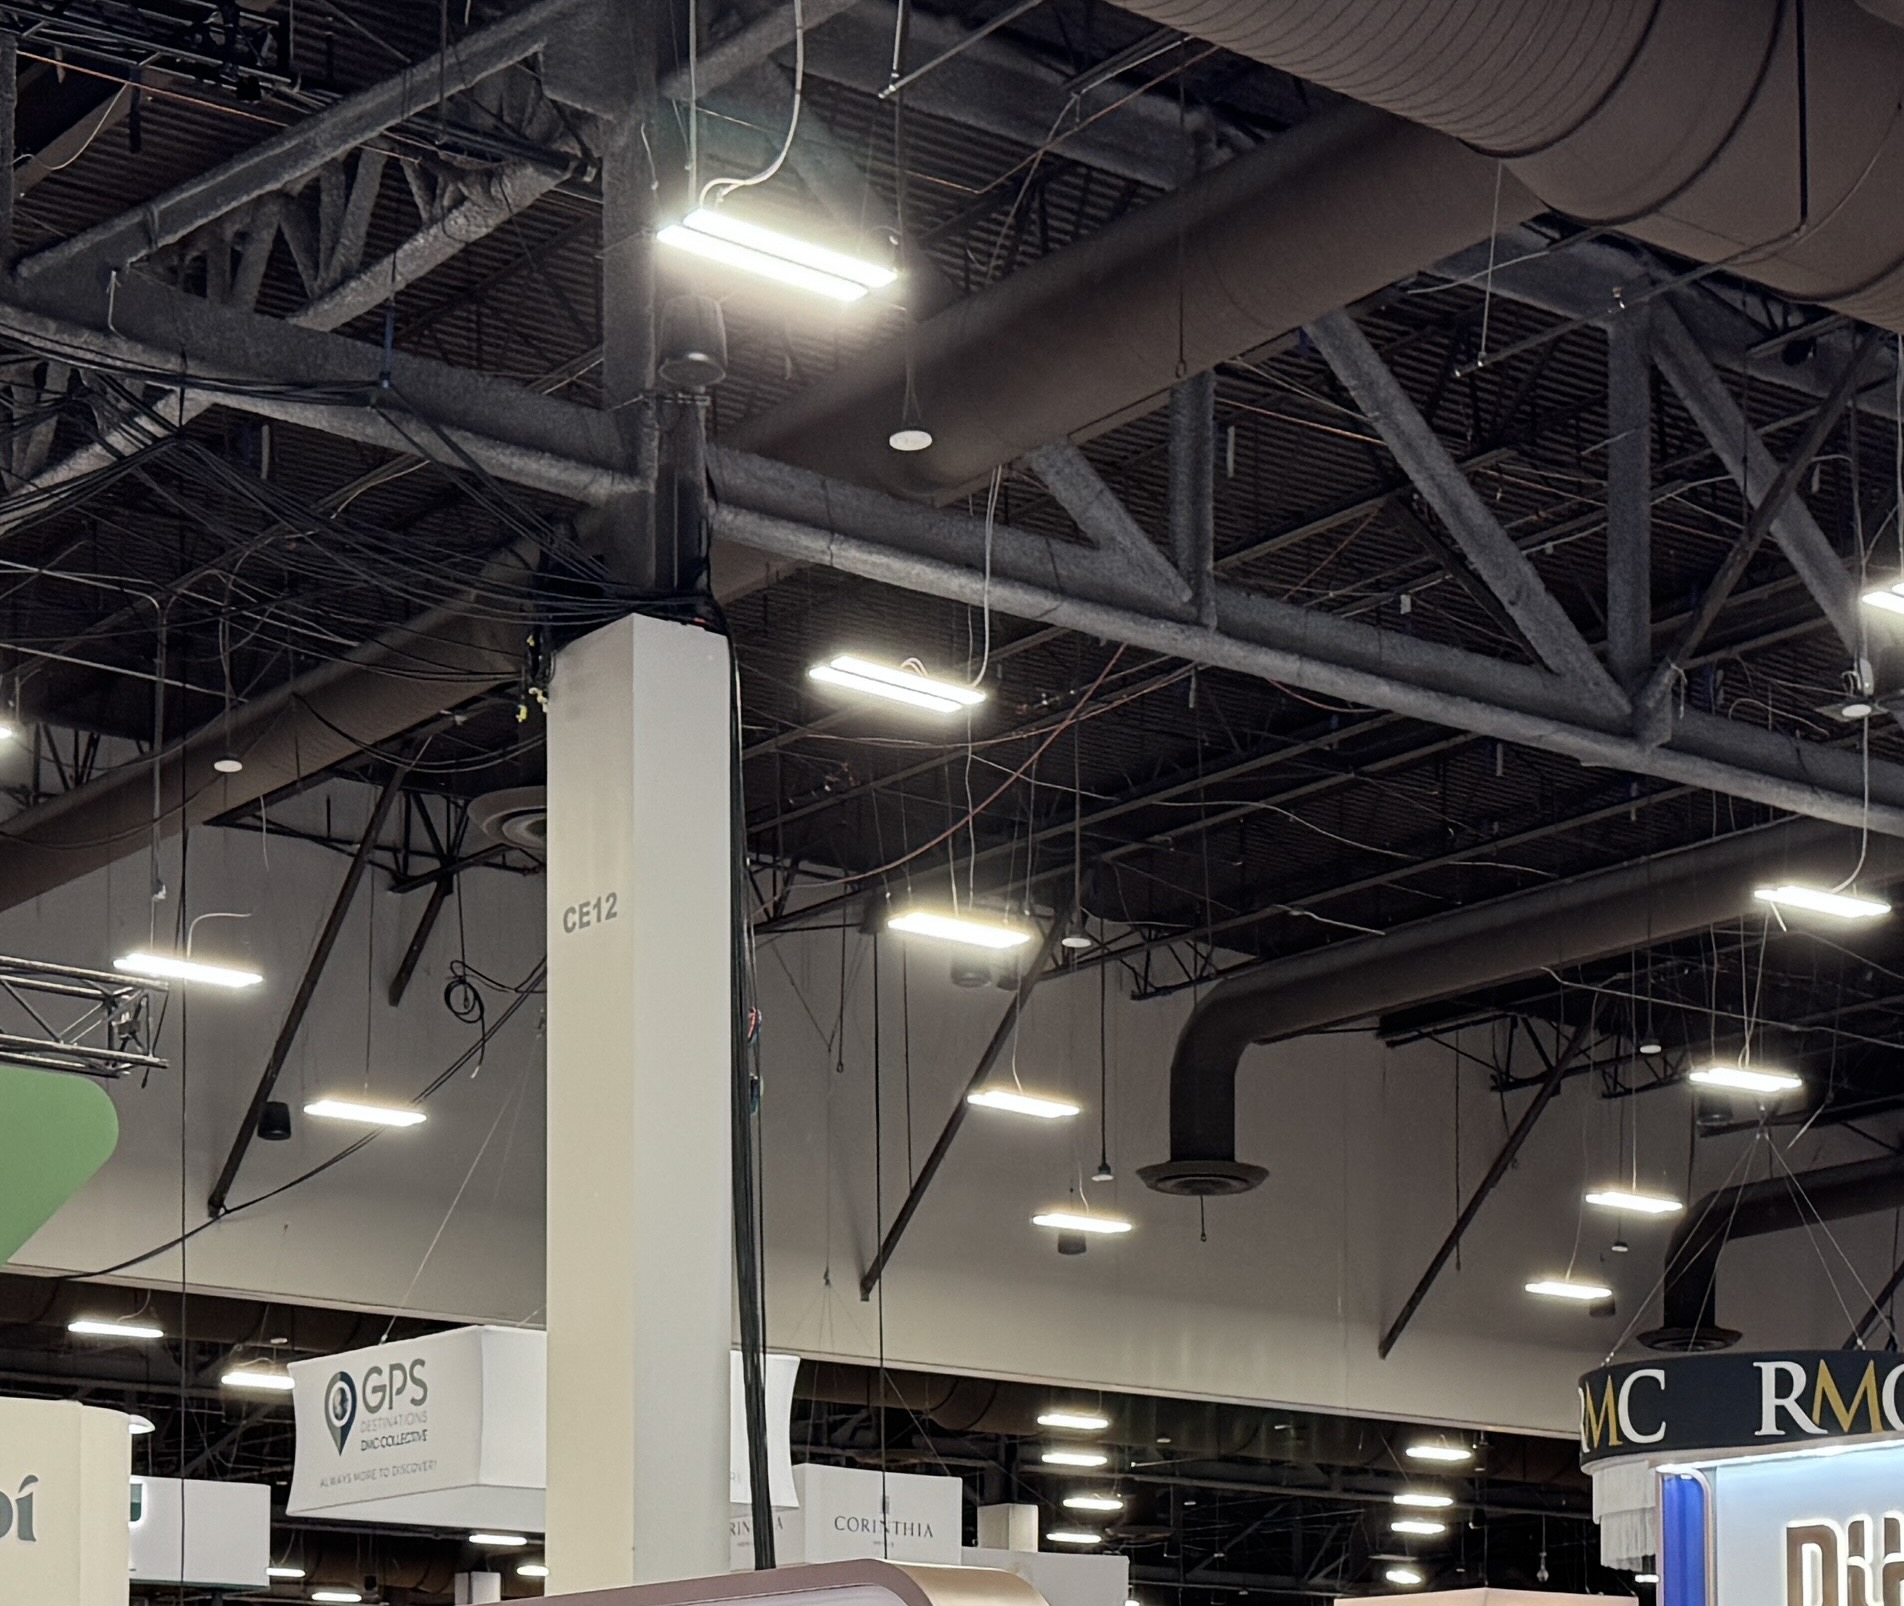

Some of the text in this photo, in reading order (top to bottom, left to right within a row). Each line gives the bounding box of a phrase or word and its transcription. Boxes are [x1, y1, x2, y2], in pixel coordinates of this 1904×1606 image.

[563, 892, 618, 934] CE12
[362, 1358, 429, 1414] GPS
[834, 1515, 934, 1538] CORINTHIA
